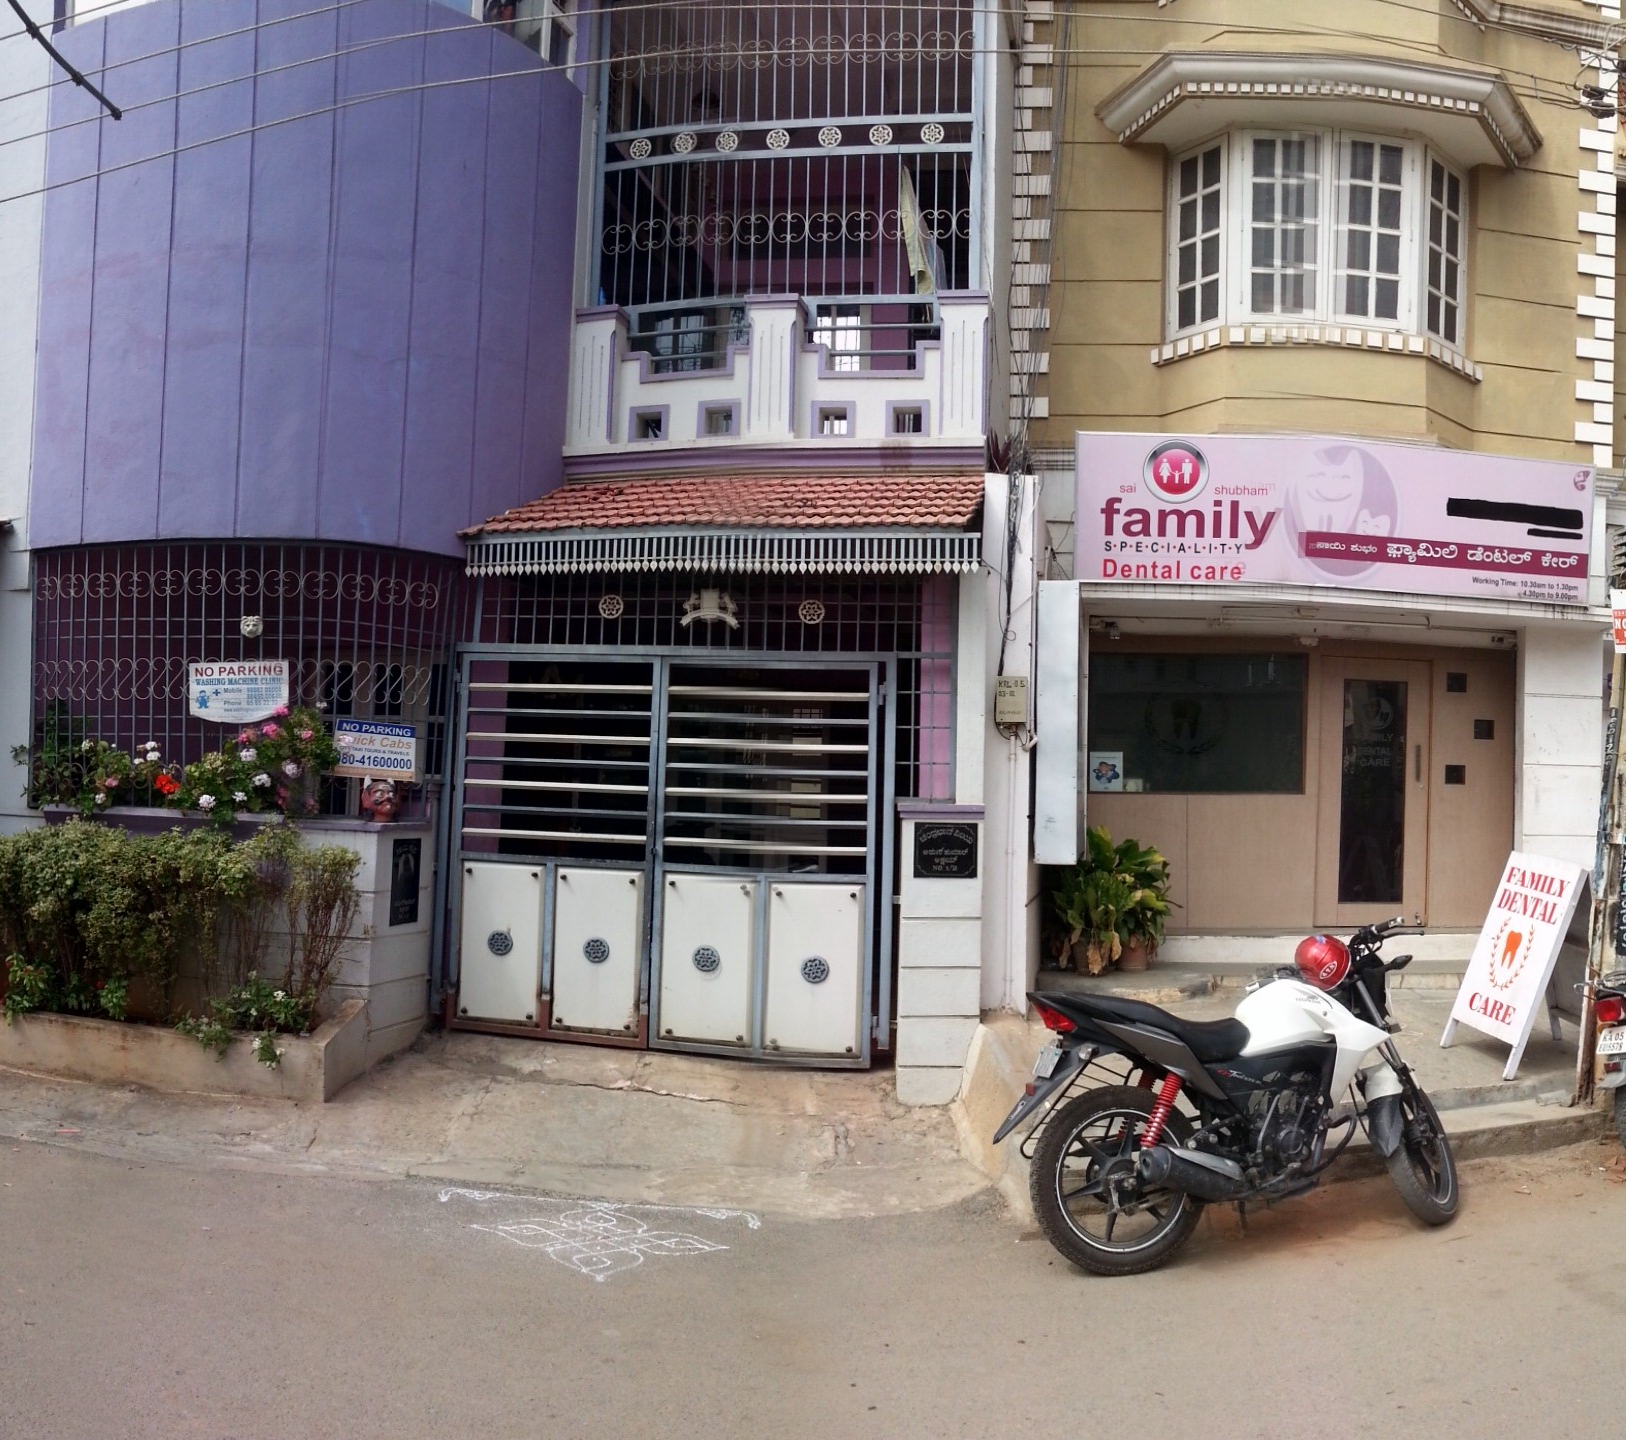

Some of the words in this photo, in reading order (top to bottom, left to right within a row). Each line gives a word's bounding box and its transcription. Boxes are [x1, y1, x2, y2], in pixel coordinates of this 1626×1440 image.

[1119, 483, 1137, 494] sai
[1214, 485, 1269, 497] shubham
[1100, 497, 1277, 550] family
[1467, 547, 1531, 565] ಡೆಂಟಲ್
[1541, 552, 1579, 568] ಕೇರ್
[1103, 559, 1181, 579] Dental
[1190, 562, 1243, 580] care
[1472, 576, 1499, 587] Working
[1500, 578, 1518, 586] Time:
[1520, 580, 1547, 589] 10.30am
[1556, 583, 1579, 592] 1.30pm
[1523, 590, 1547, 599] 4.30pm
[195, 666, 214, 677] NO
[218, 665, 283, 676] PARKING
[195, 678, 226, 686] WASHING
[228, 677, 258, 686] MACHINE
[342, 722, 359, 732] NO
[361, 724, 411, 737] PARKING
[337, 733, 375, 746] ick
[380, 737, 412, 750] Cabs
[1506, 866, 1572, 898] FAMILY
[1497, 888, 1558, 925] DENTAL
[1468, 991, 1517, 1026] CARE
[1602, 1033, 1613, 1042] KA
[1614, 1031, 1625, 1041] 05
